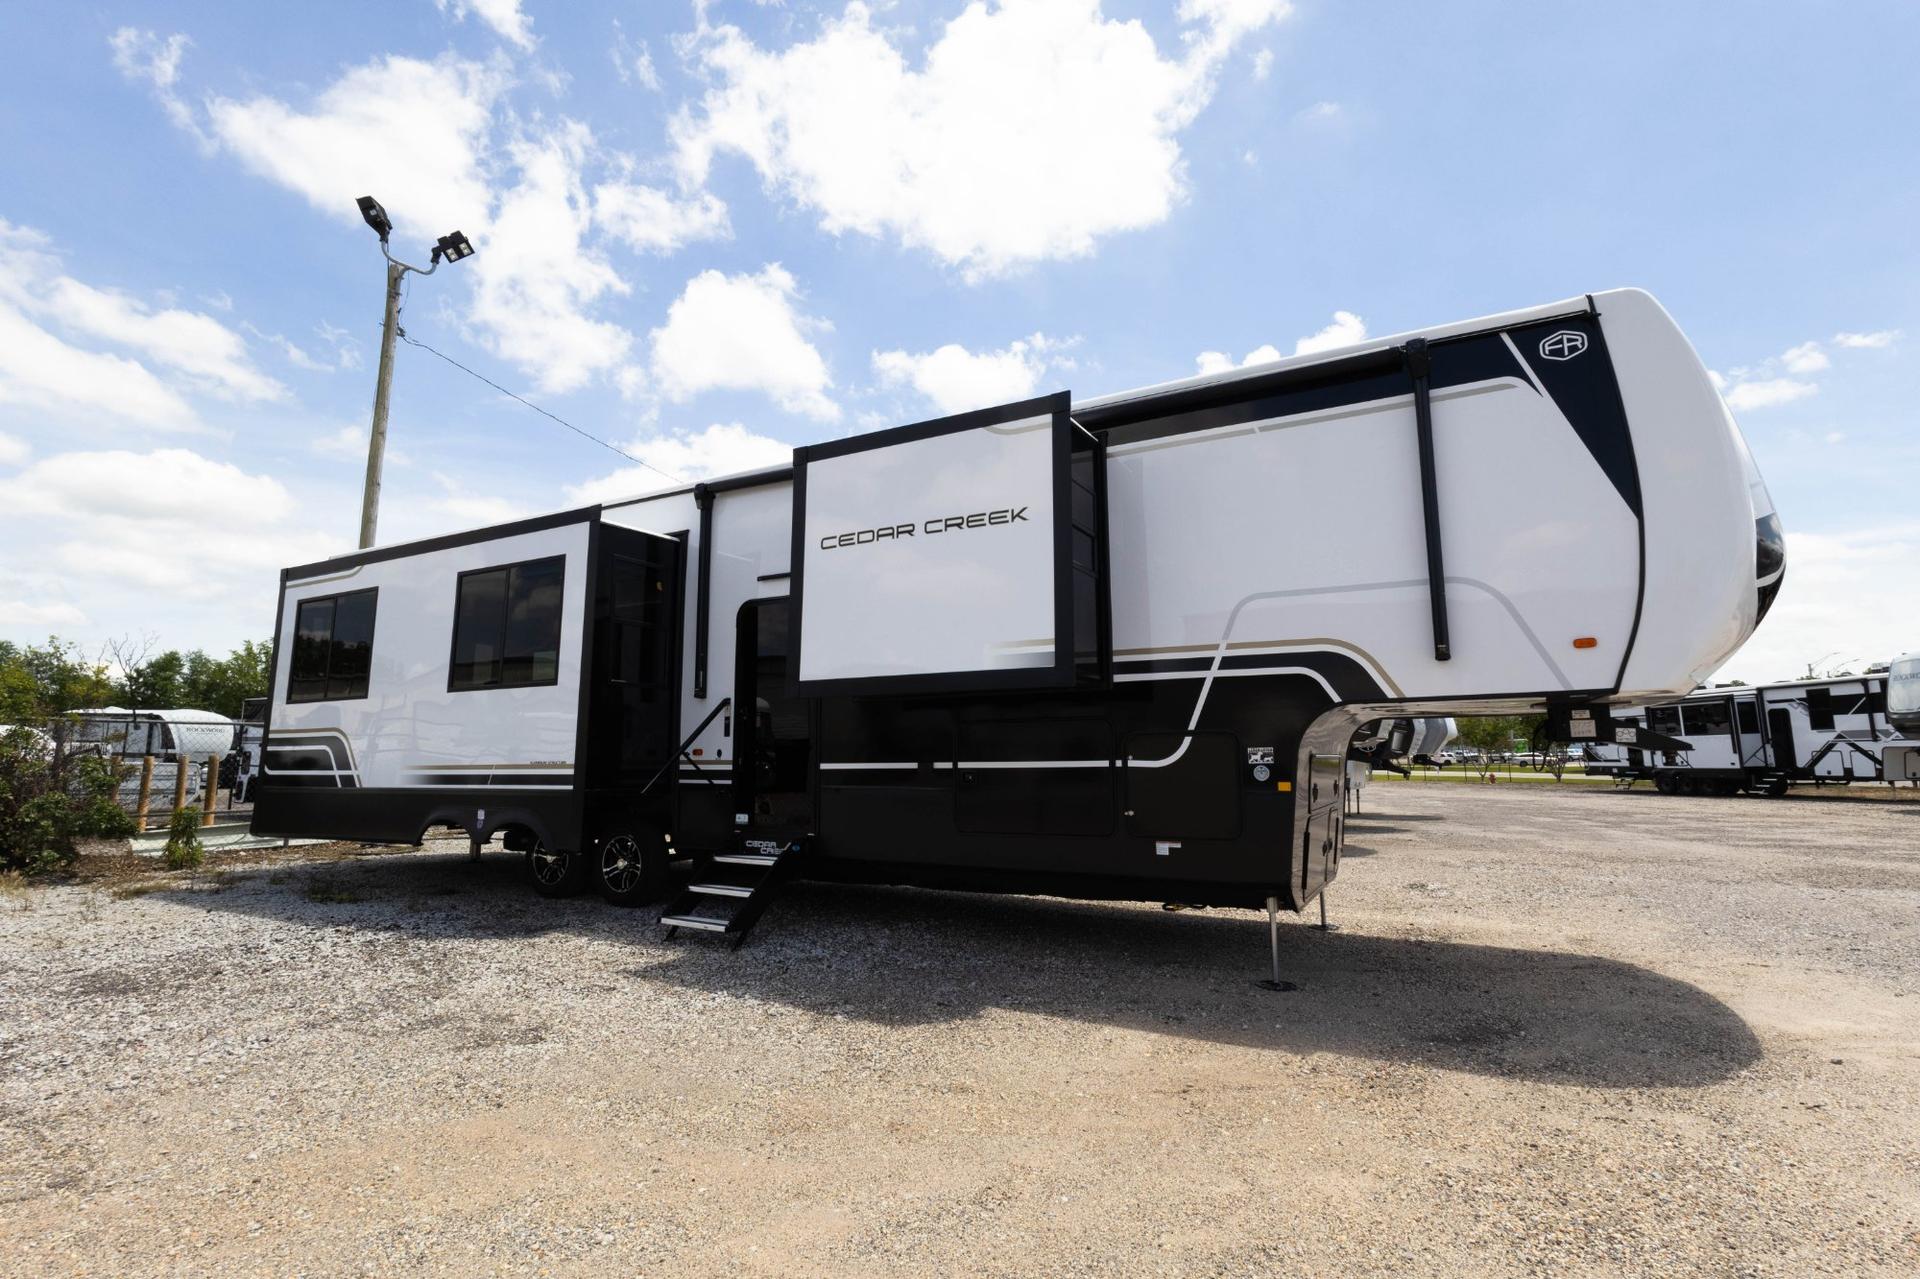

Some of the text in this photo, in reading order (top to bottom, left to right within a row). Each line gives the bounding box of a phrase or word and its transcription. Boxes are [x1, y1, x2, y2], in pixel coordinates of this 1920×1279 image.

[1543, 333, 1584, 357] FR
[821, 507, 1030, 550] CEDAR CREEK
[746, 840, 777, 848] CEDAR
